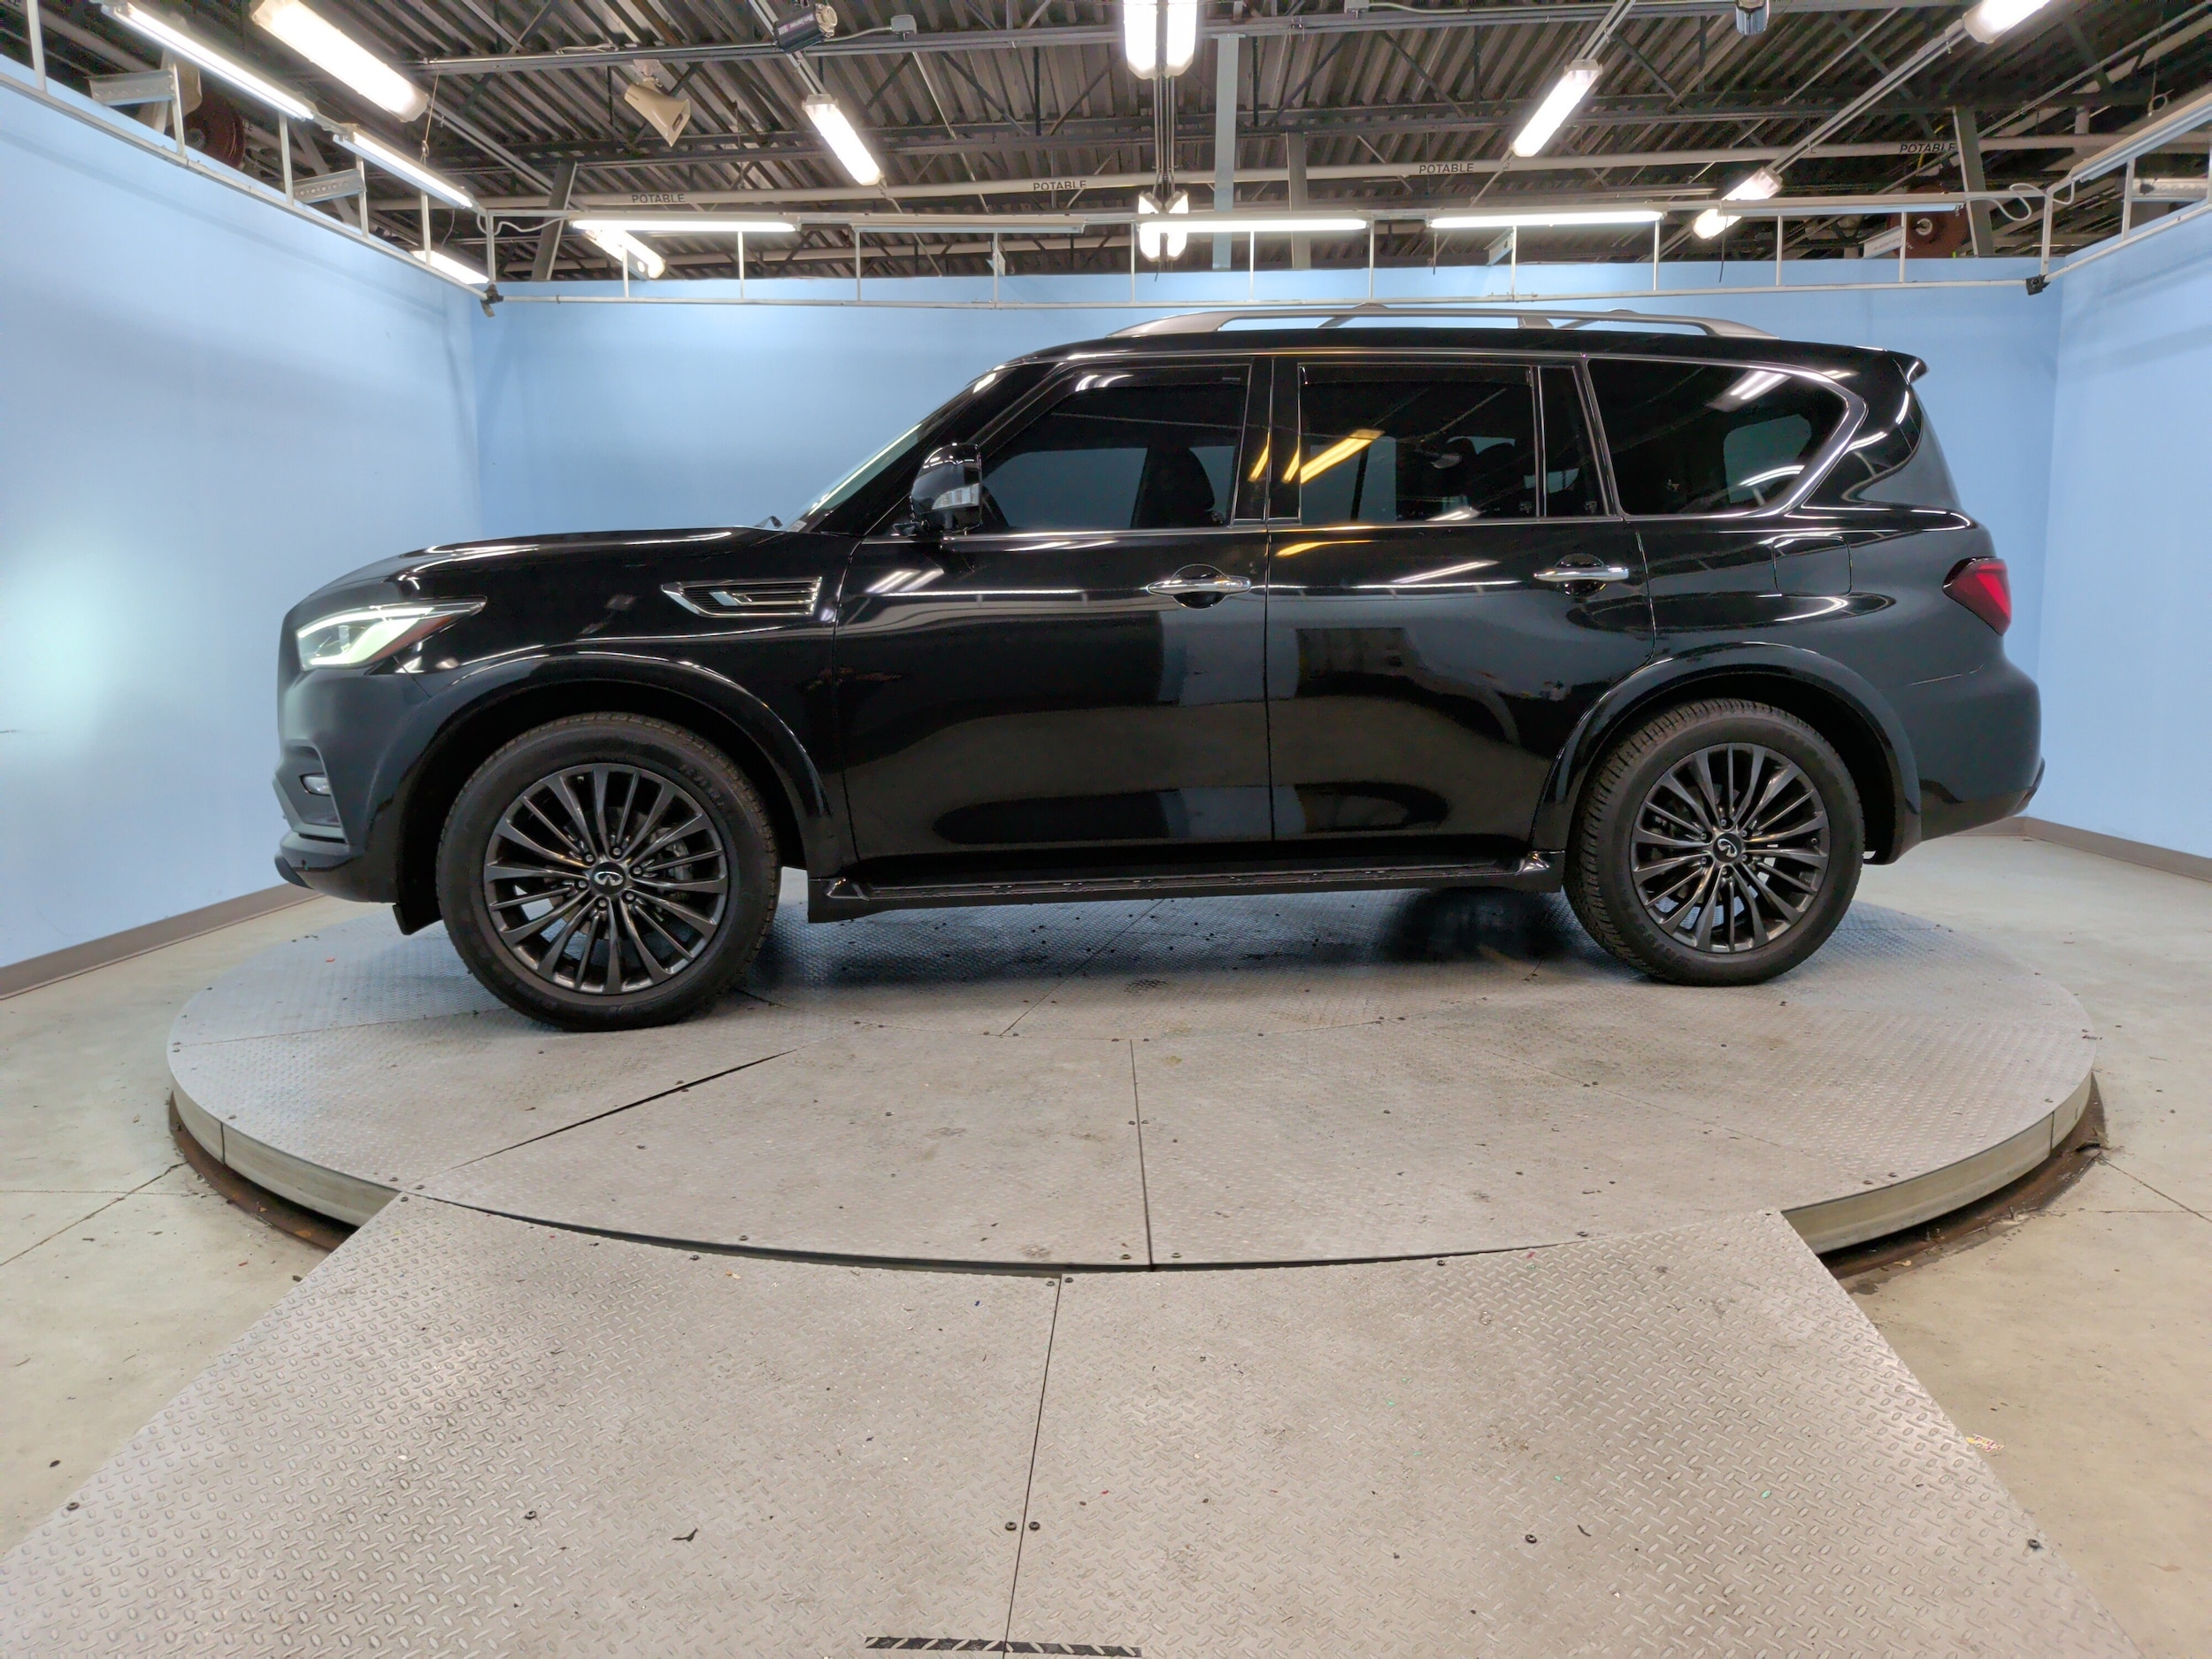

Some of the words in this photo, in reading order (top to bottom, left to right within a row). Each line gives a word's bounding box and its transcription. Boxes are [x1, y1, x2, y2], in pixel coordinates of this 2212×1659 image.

[1419, 163, 1474, 174] POTABLE
[1033, 180, 1087, 191] POTABLE
[632, 194, 686, 204] POTABLE
